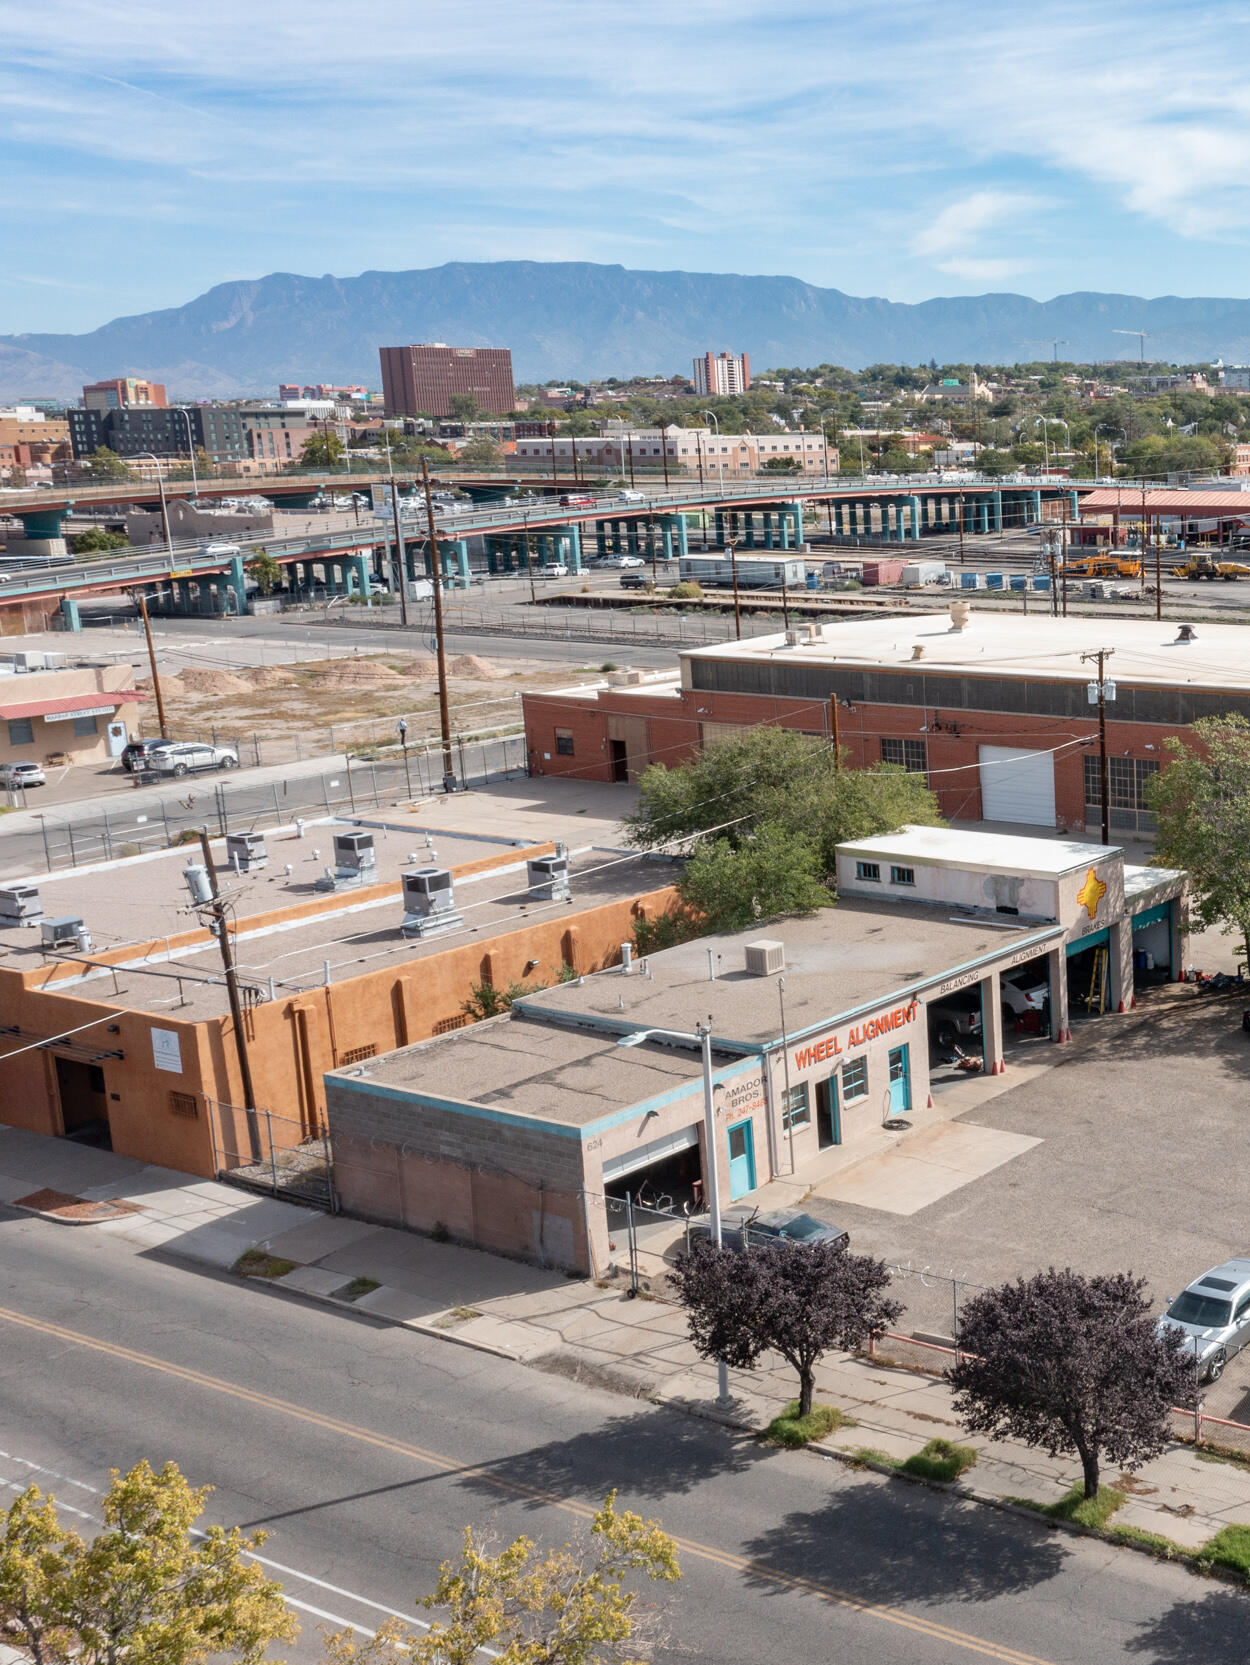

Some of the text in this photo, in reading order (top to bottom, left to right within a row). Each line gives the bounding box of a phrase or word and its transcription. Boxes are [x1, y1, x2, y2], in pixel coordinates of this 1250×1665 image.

[1081, 919, 1105, 936] BRAKES
[1011, 943, 1047, 965] ALIGNMENT
[940, 971, 979, 994] BALANCING
[795, 1001, 918, 1071] WHEEL ALIGNMENT
[725, 1075, 768, 1100] AMADOR
[587, 1137, 603, 1152] 624
